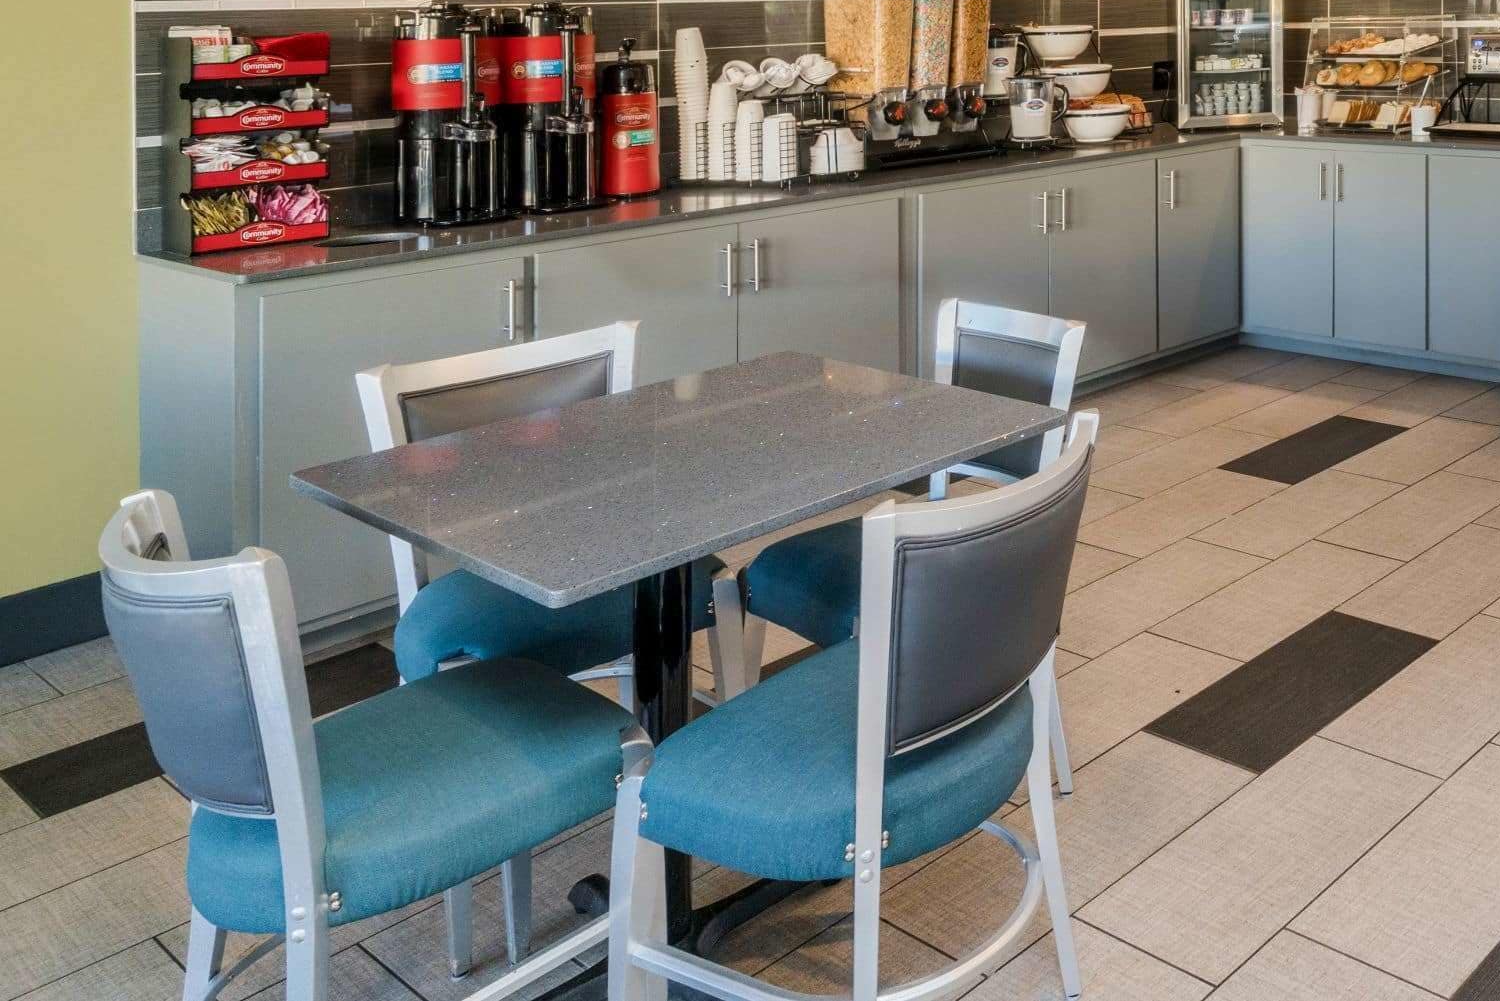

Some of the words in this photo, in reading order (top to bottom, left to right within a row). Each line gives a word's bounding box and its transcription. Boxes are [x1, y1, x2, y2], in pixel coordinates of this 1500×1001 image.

[242, 62, 283, 71] Community
[242, 114, 282, 124] Community
[242, 166, 282, 178] Community
[242, 227, 283, 240] Community
